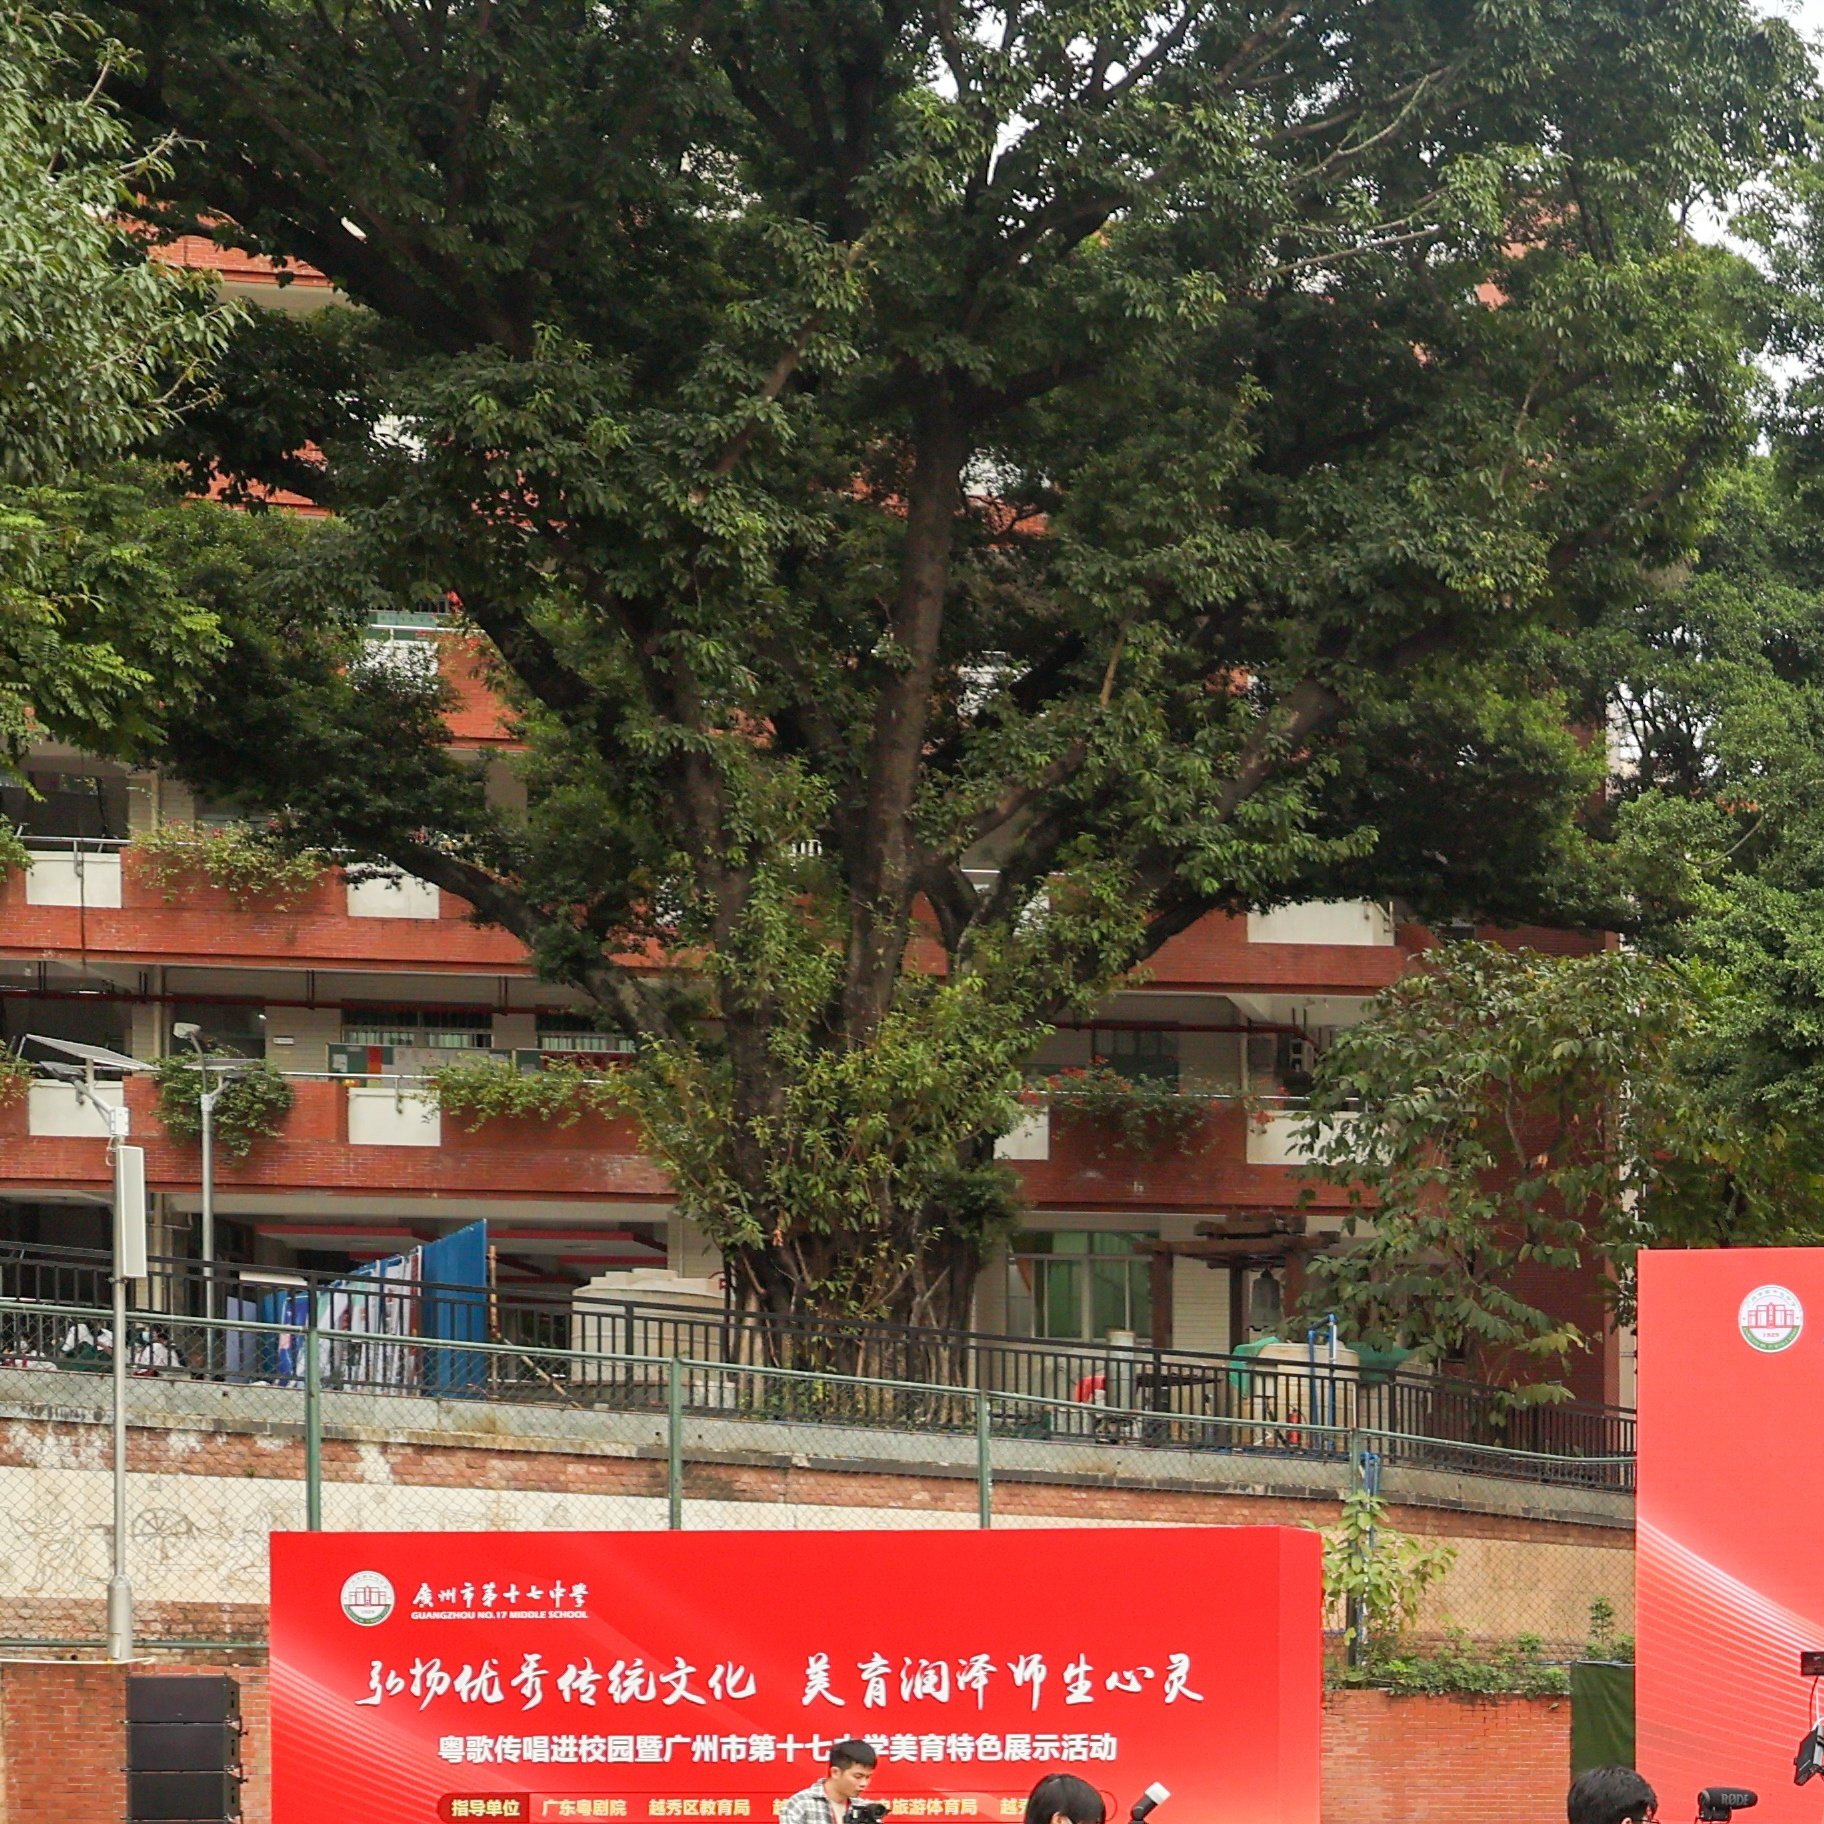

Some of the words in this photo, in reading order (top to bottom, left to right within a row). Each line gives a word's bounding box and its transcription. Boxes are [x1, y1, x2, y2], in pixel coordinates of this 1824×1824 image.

[410, 1611, 475, 1620] GUANGZHOU
[477, 1610, 507, 1619] NO.17
[509, 1610, 547, 1619] MIDDLE
[548, 1610, 588, 1619] SCHOOL
[354, 1653, 757, 1710] 弘扬优秀传统文化
[801, 1652, 1204, 1711] 美育润泽师生心灵
[437, 1732, 1118, 1763] 粤歌传唱进校园暨广州市第十七学美育特色展示活动
[451, 1799, 521, 1817] 指导单位
[541, 1799, 627, 1817] 广东粤剧院
[648, 1798, 751, 1817] 越秀区教育局
